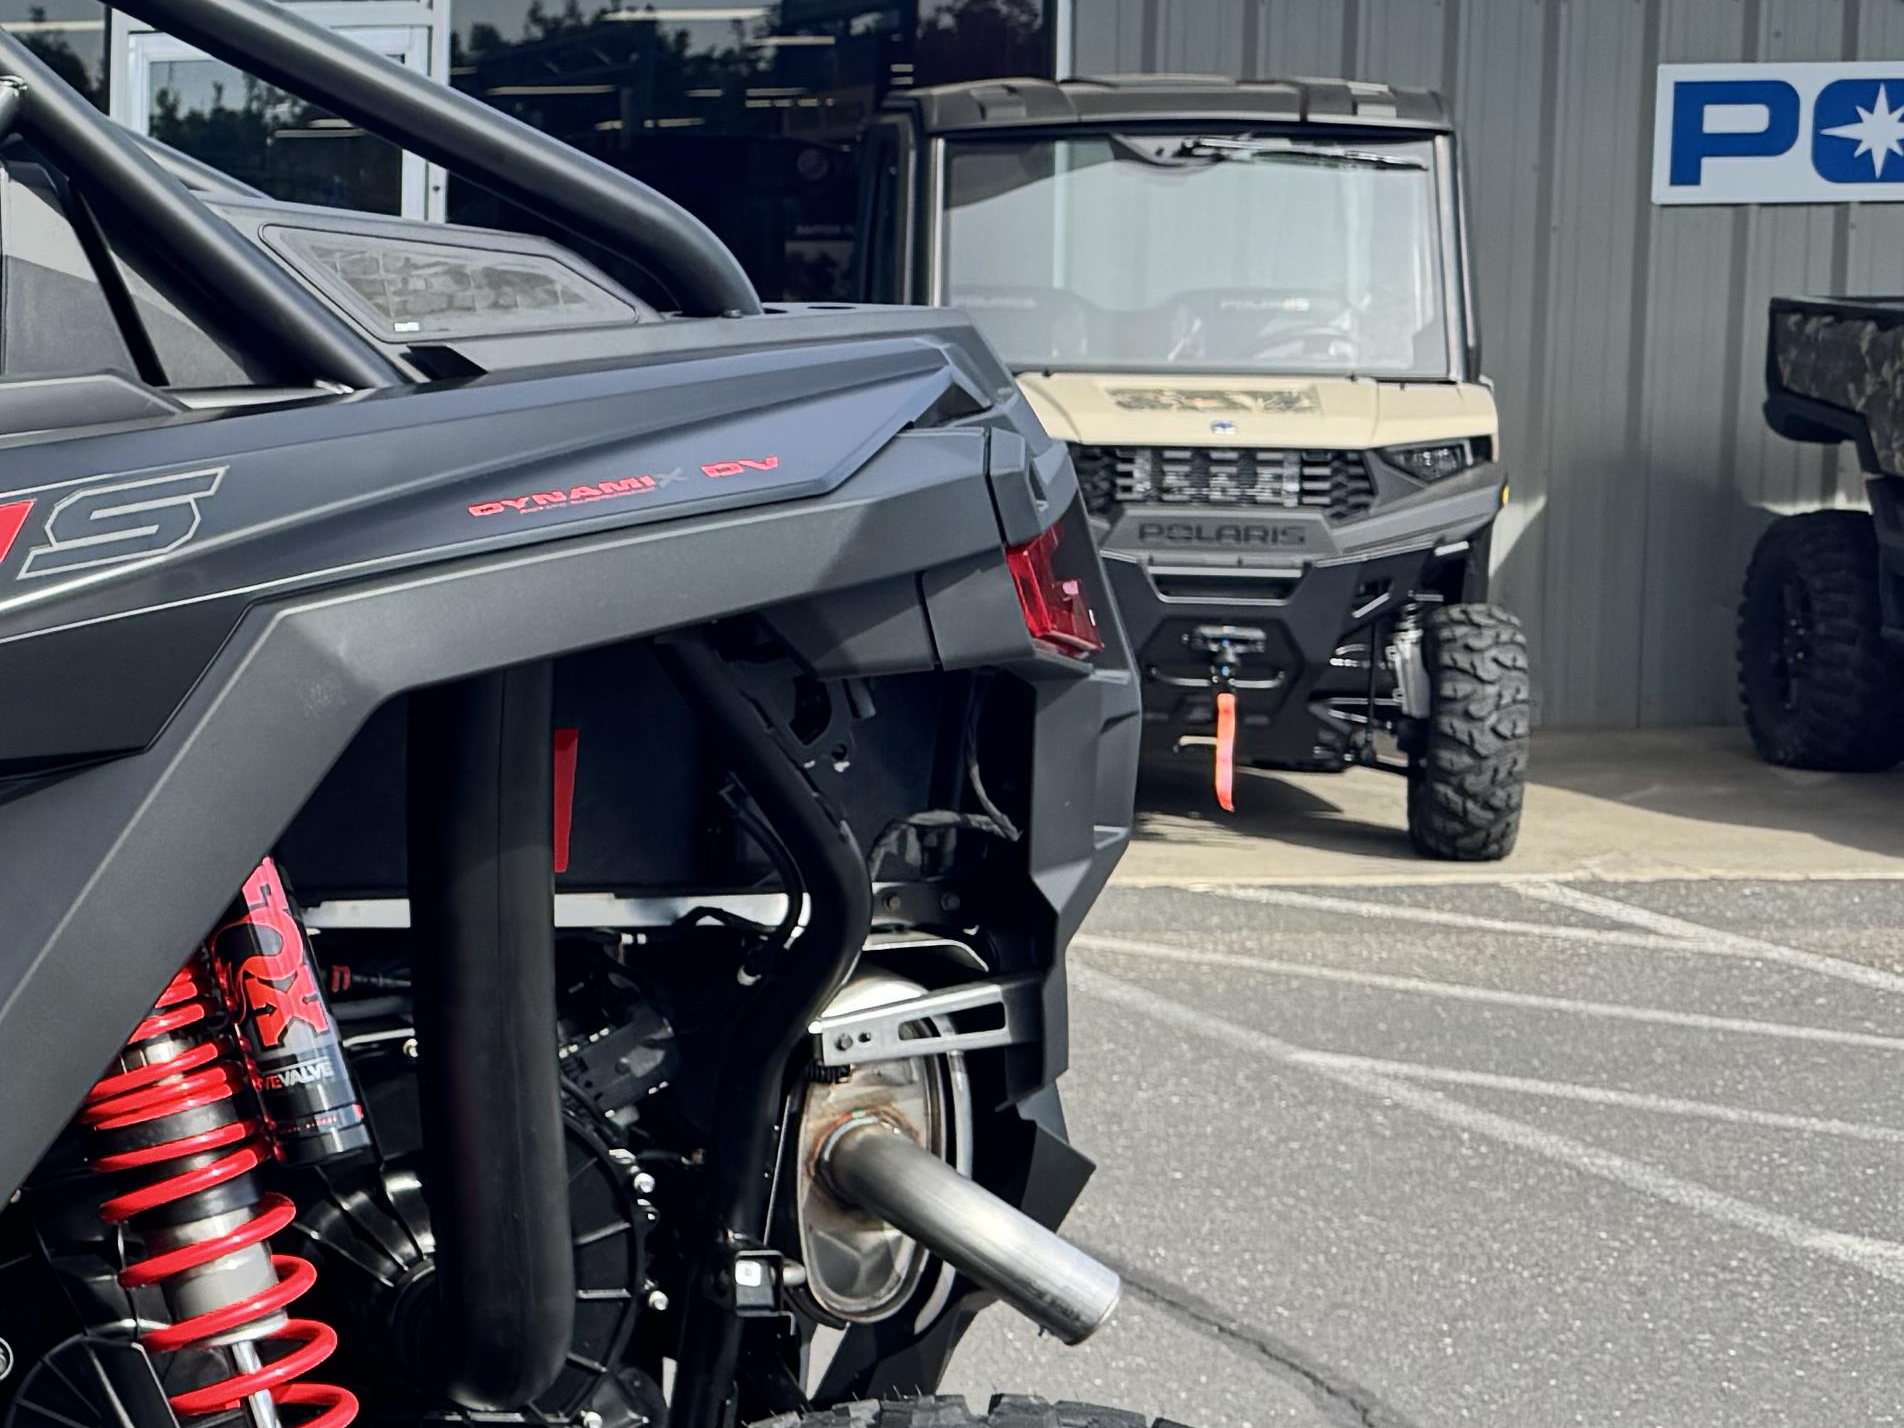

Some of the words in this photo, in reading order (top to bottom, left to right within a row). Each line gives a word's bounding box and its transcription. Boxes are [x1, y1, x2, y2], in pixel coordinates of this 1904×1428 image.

[468, 467, 690, 517] DYNAMIX
[700, 456, 779, 478] DV
[16, 466, 230, 581] S
[1137, 521, 1306, 546] POLARIS
